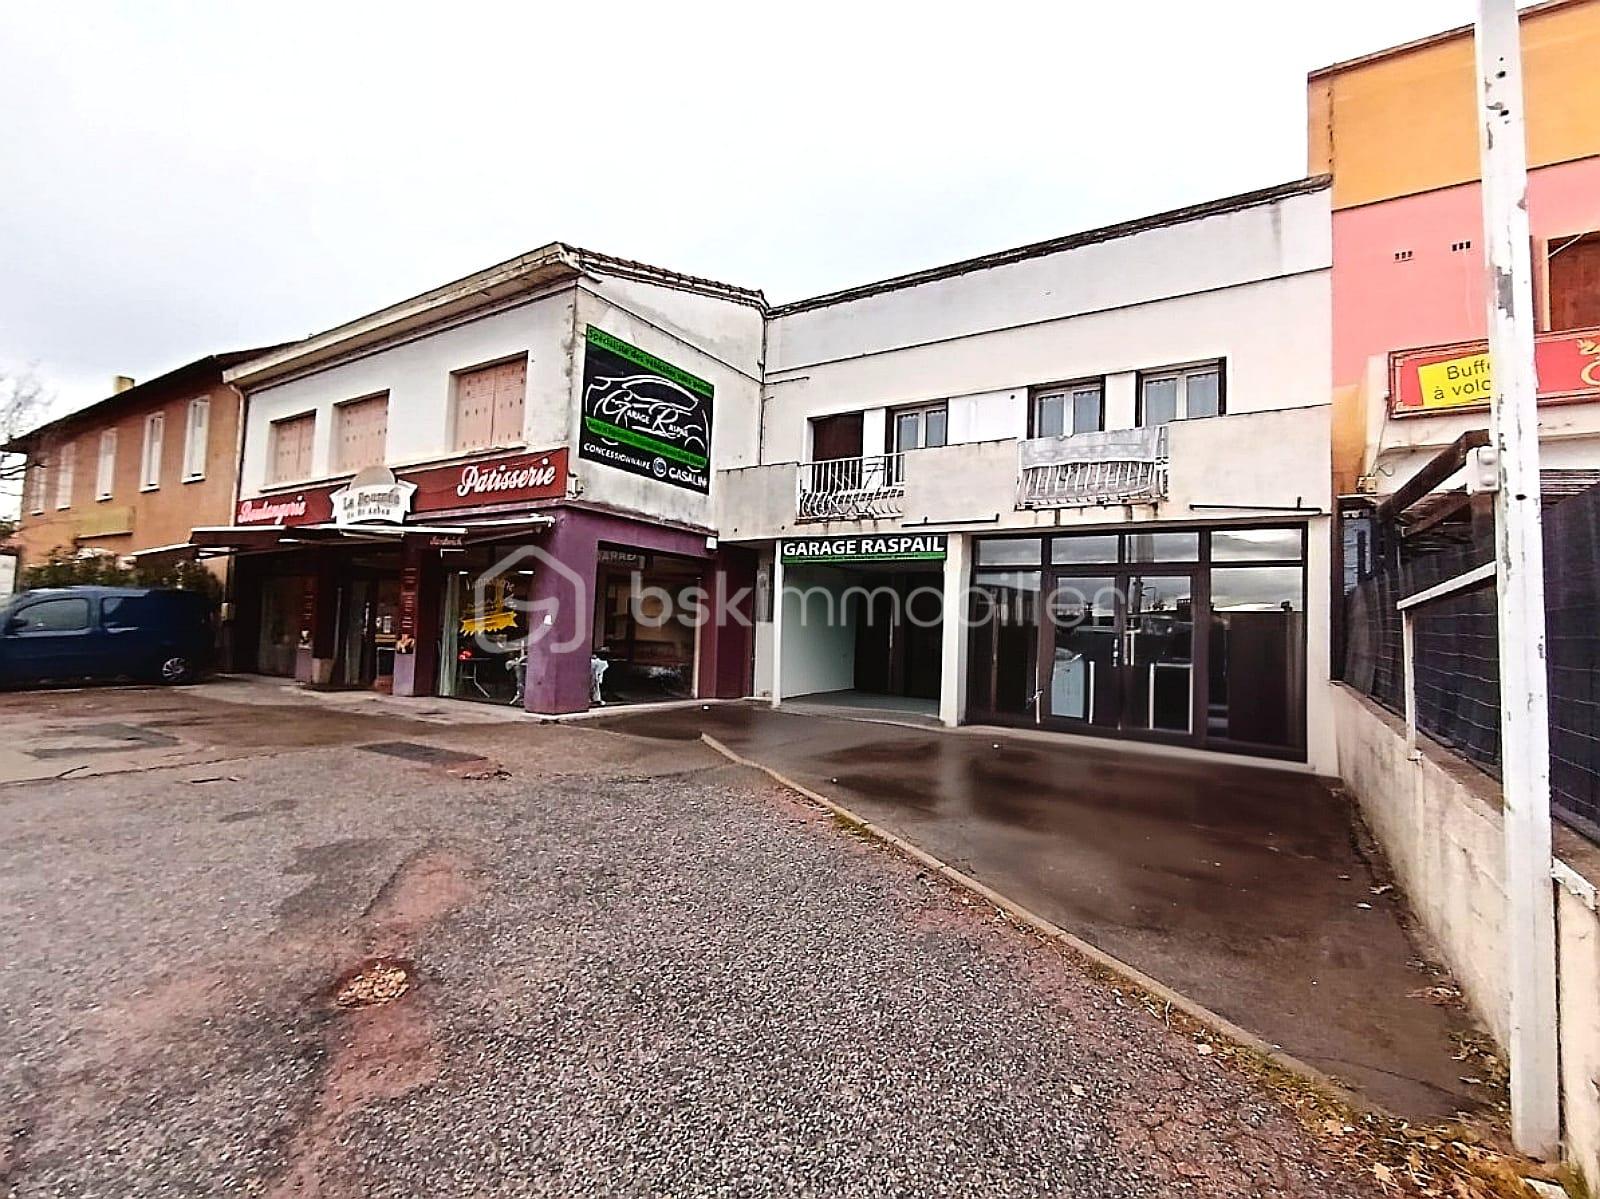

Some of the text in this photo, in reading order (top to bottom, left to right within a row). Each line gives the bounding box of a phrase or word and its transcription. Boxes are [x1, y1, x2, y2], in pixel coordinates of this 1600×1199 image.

[1447, 358, 1490, 380] Buff
[1433, 379, 1491, 400] à volo
[783, 540, 857, 556] GARAGE
[861, 536, 945, 554] RASPAIL
